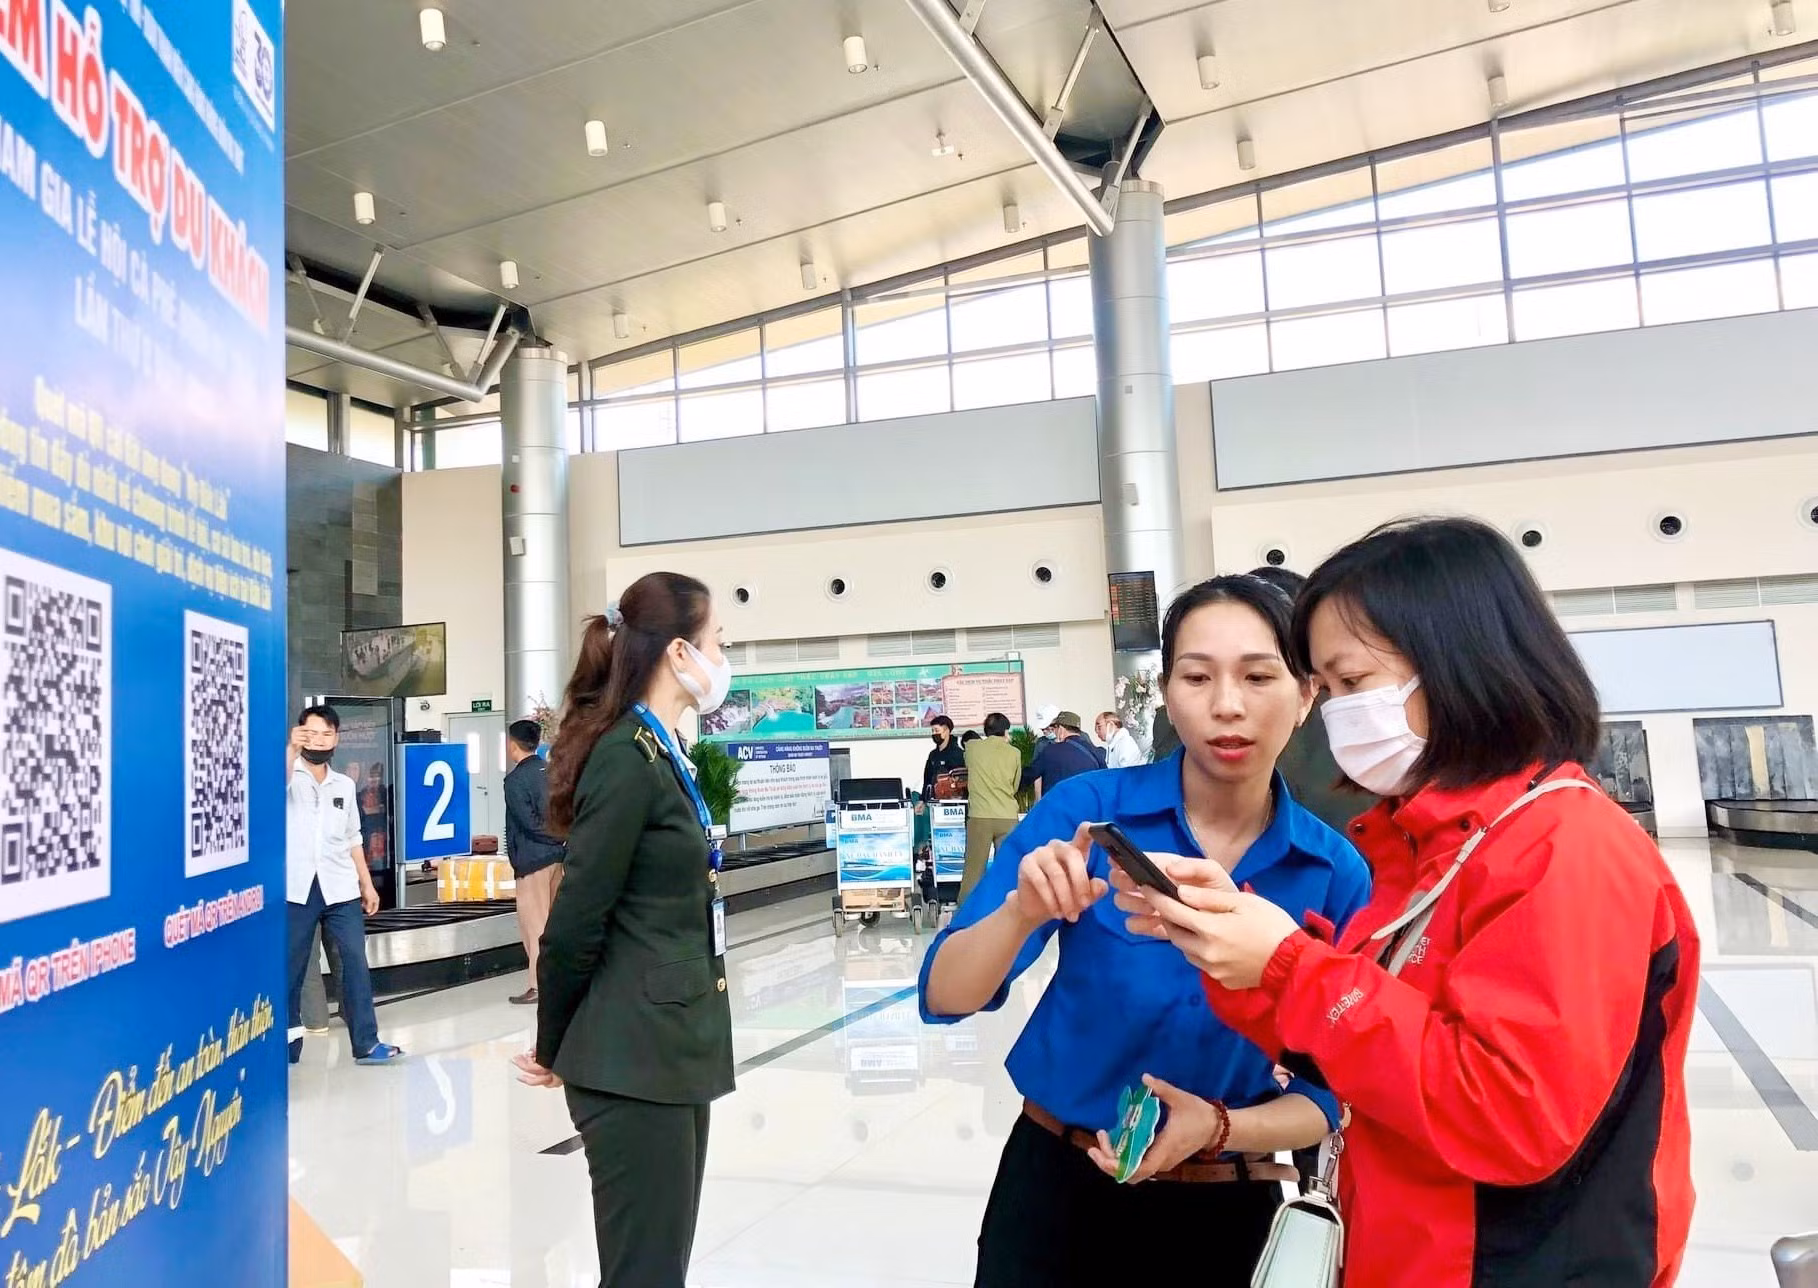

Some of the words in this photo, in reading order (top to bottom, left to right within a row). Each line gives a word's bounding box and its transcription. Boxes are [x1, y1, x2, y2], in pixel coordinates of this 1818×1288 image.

[40, 161, 73, 235] GIA
[110, 68, 168, 246] TRỢ
[170, 147, 206, 271] DU
[738, 745, 754, 760] ACV
[422, 760, 455, 841] 2
[851, 813, 872, 821] BMA
[944, 807, 964, 816] BMA
[205, 900, 218, 932] QR
[25, 955, 50, 1002] QR
[51, 937, 90, 992] TRÊN
[89, 927, 136, 978] IPHONE
[88, 1065, 146, 1159] Điểm
[147, 1042, 175, 1115] đến
[176, 1056, 195, 1095] an
[83, 1183, 120, 1260] bản
[119, 1150, 151, 1227] sắc
[155, 1115, 190, 1209] Tây
